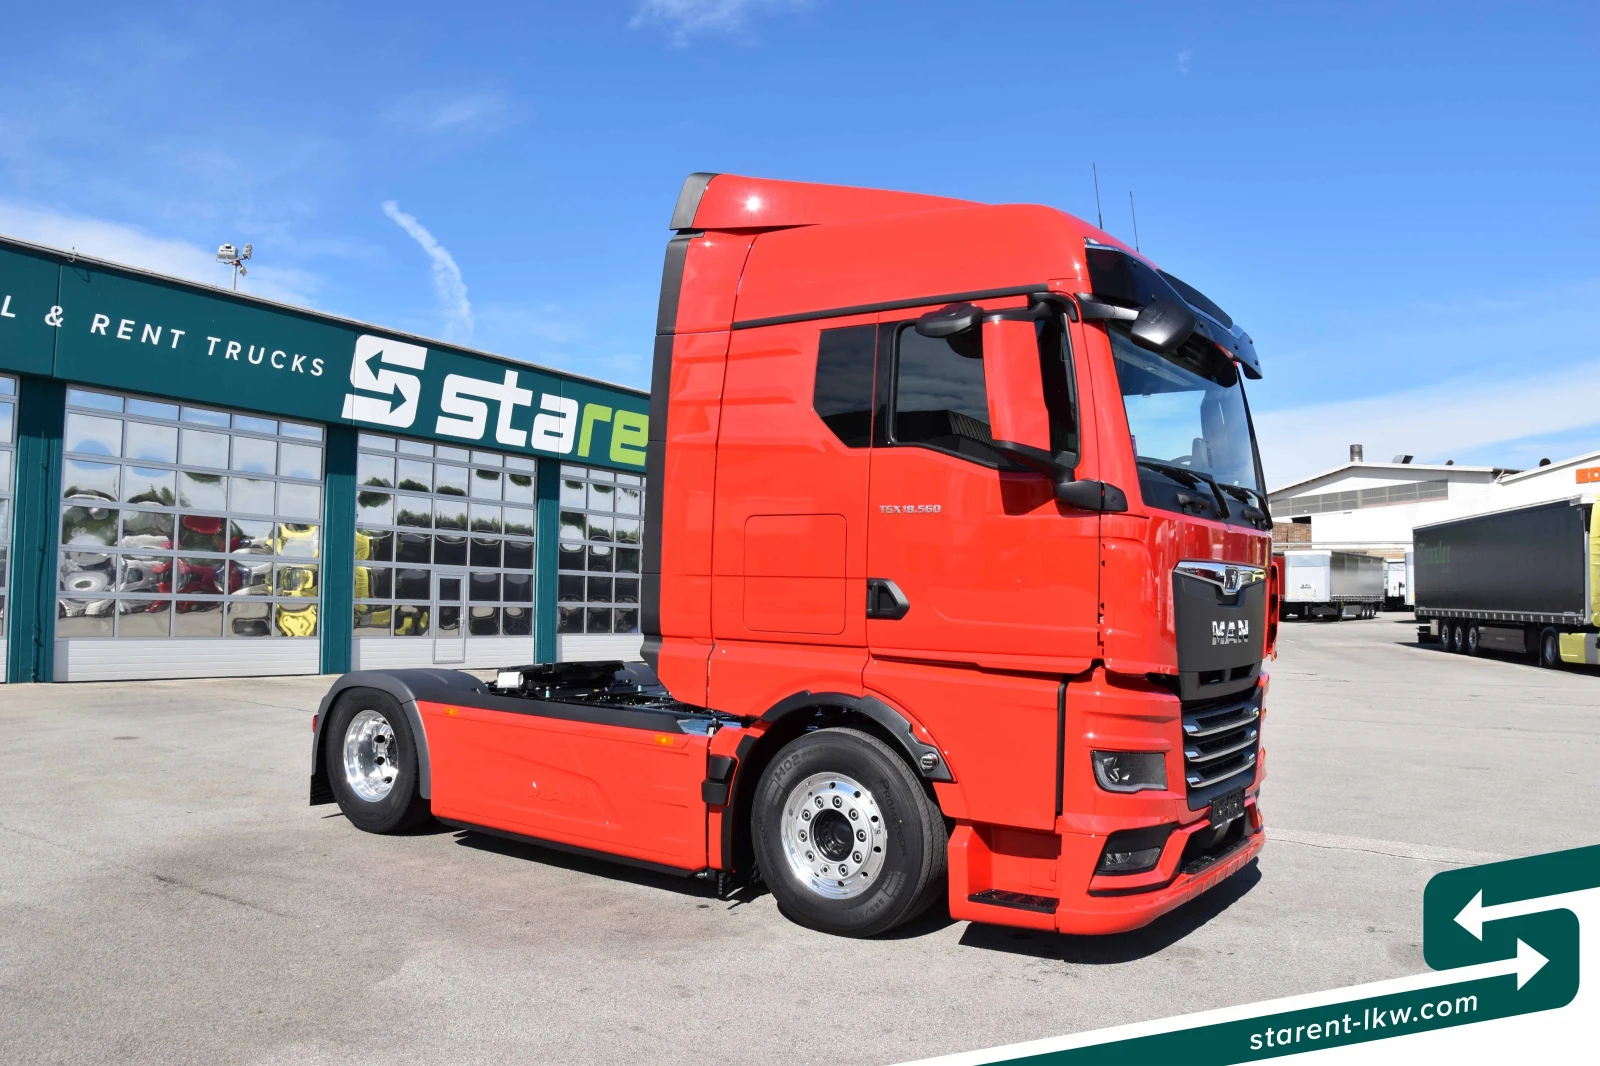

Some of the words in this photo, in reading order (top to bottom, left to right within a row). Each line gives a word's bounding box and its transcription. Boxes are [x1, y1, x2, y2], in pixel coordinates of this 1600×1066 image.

[0, 295, 16, 318] L
[44, 305, 64, 327] &
[90, 313, 186, 349] RENT
[206, 336, 325, 377] TRUCKS
[435, 369, 650, 466] stare
[879, 505, 901, 514] TGX
[902, 504, 942, 514] 18.560
[1211, 620, 1249, 646] MAN
